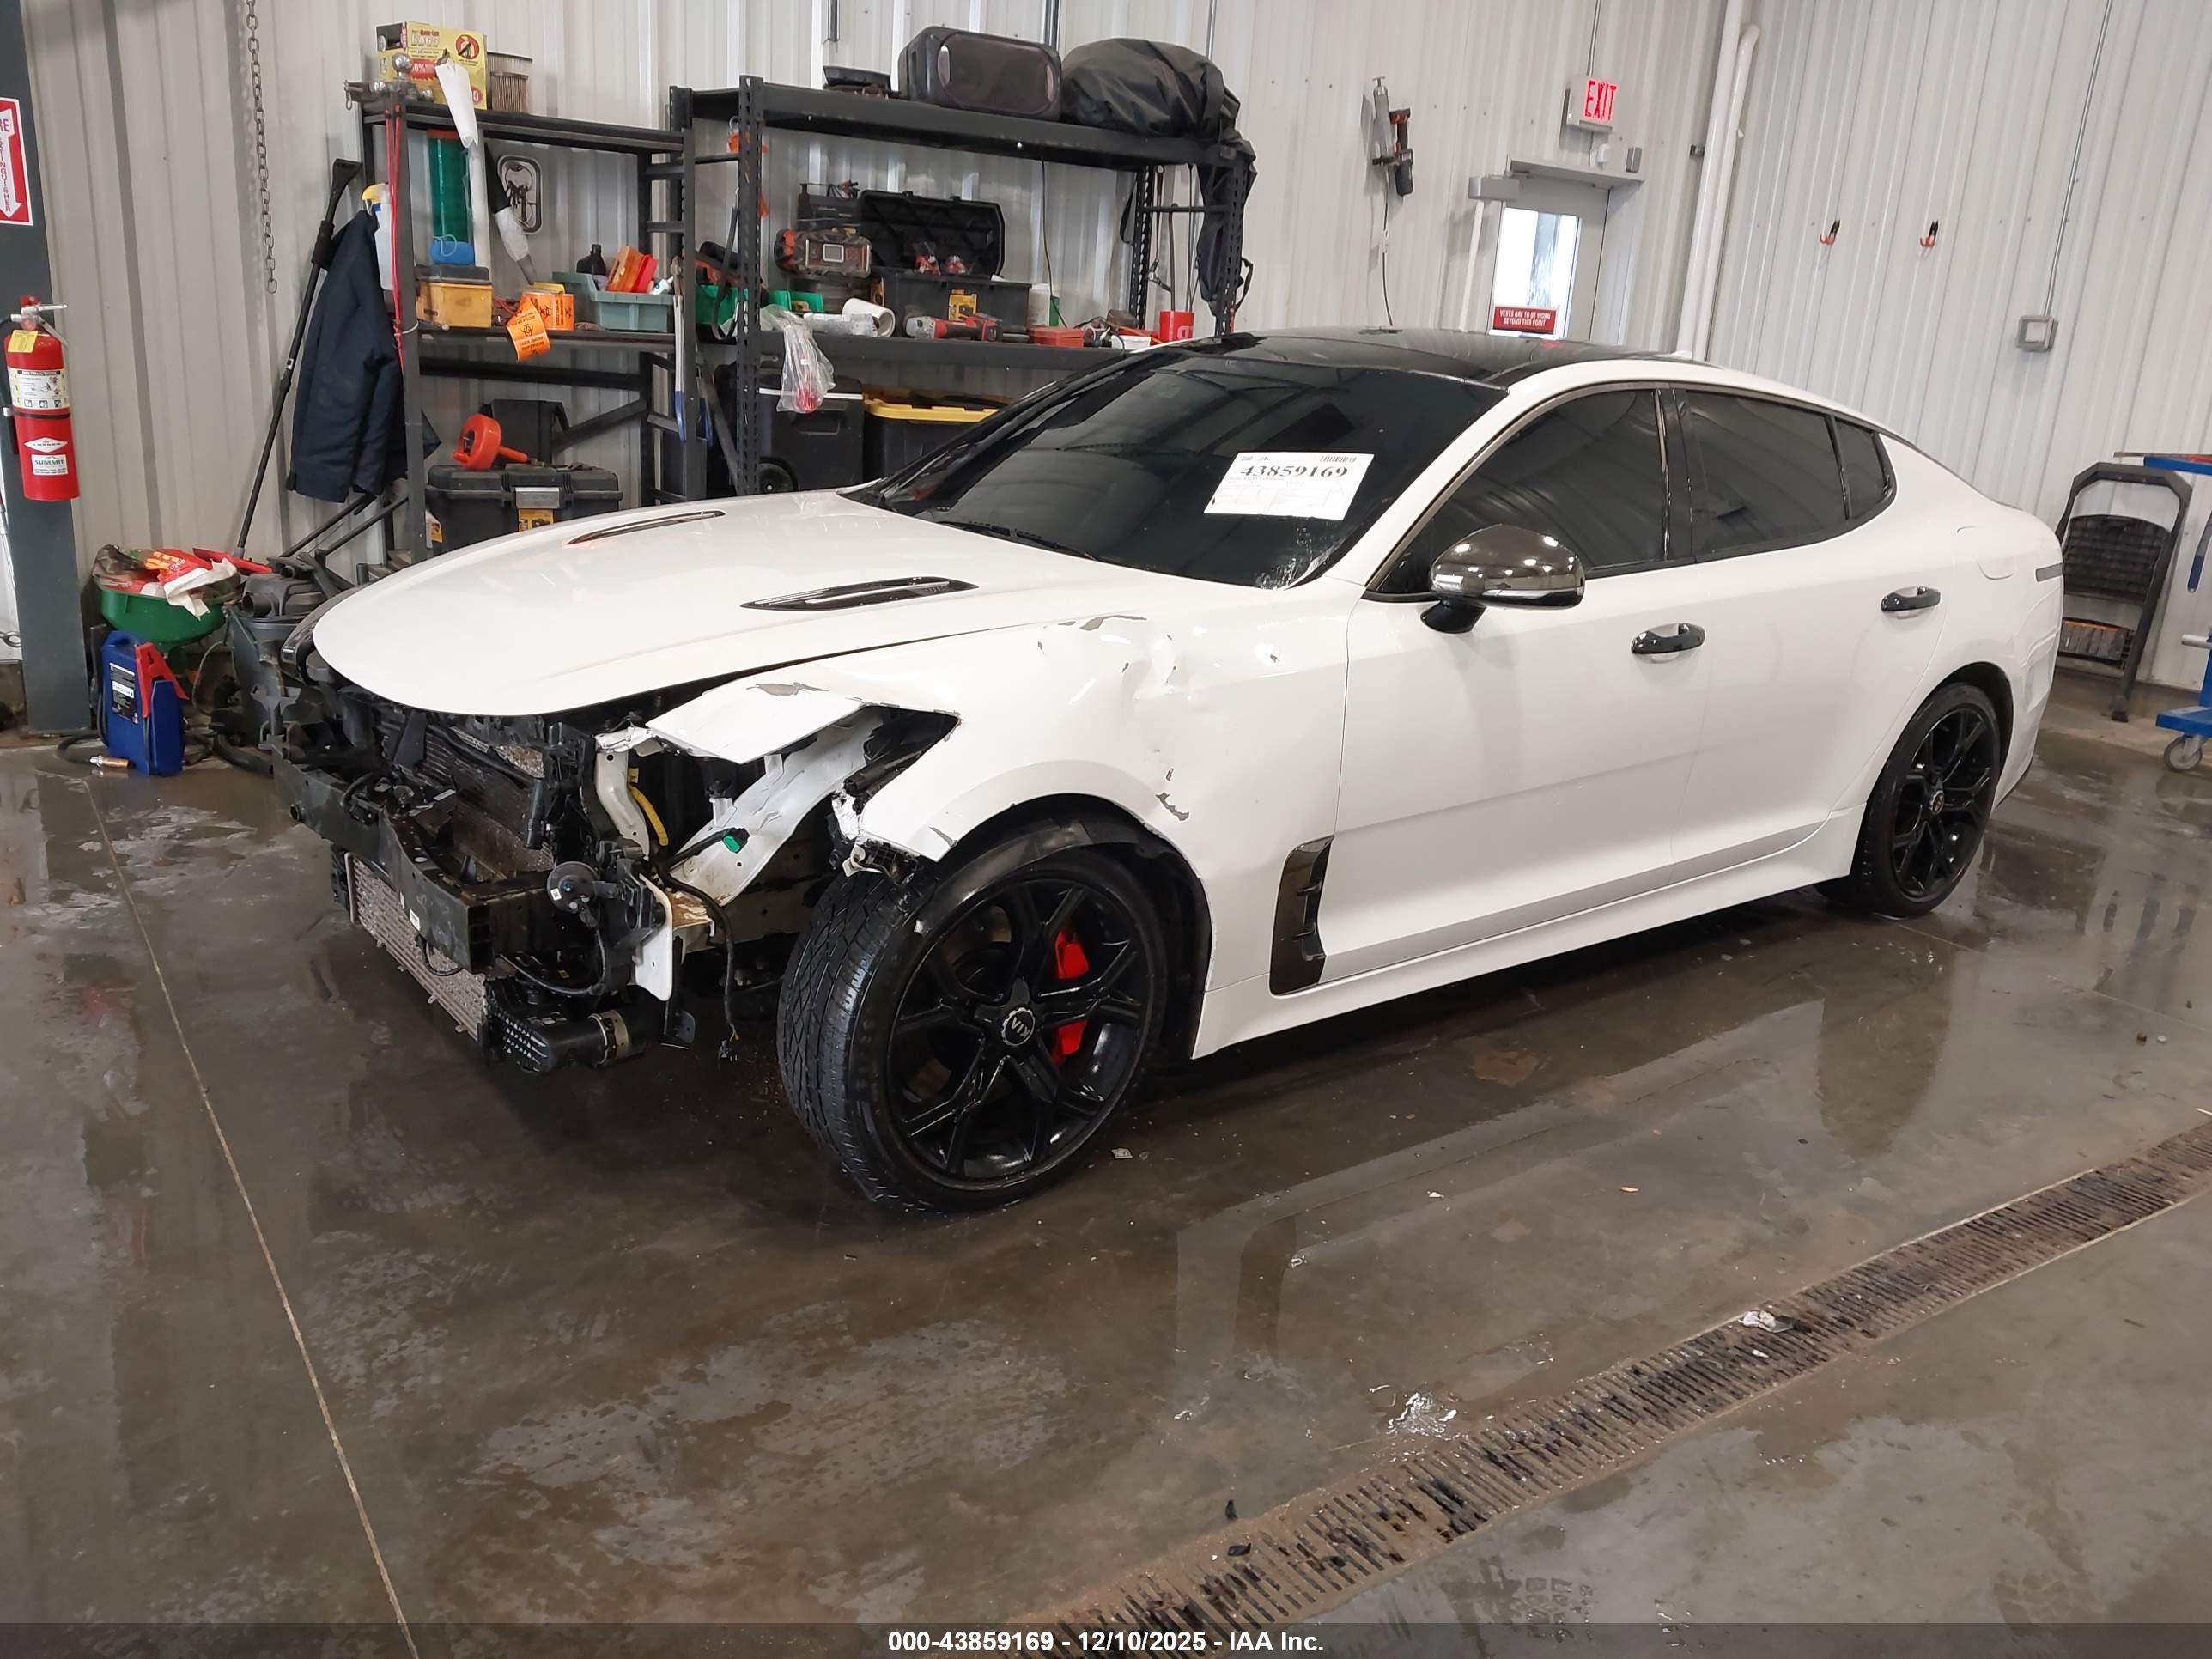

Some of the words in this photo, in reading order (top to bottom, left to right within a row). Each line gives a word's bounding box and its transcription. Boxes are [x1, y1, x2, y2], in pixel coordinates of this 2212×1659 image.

[1584, 80, 1617, 120] EXIT
[1241, 465, 1348, 478] 43859169
[1011, 1017, 1030, 1039] KIA
